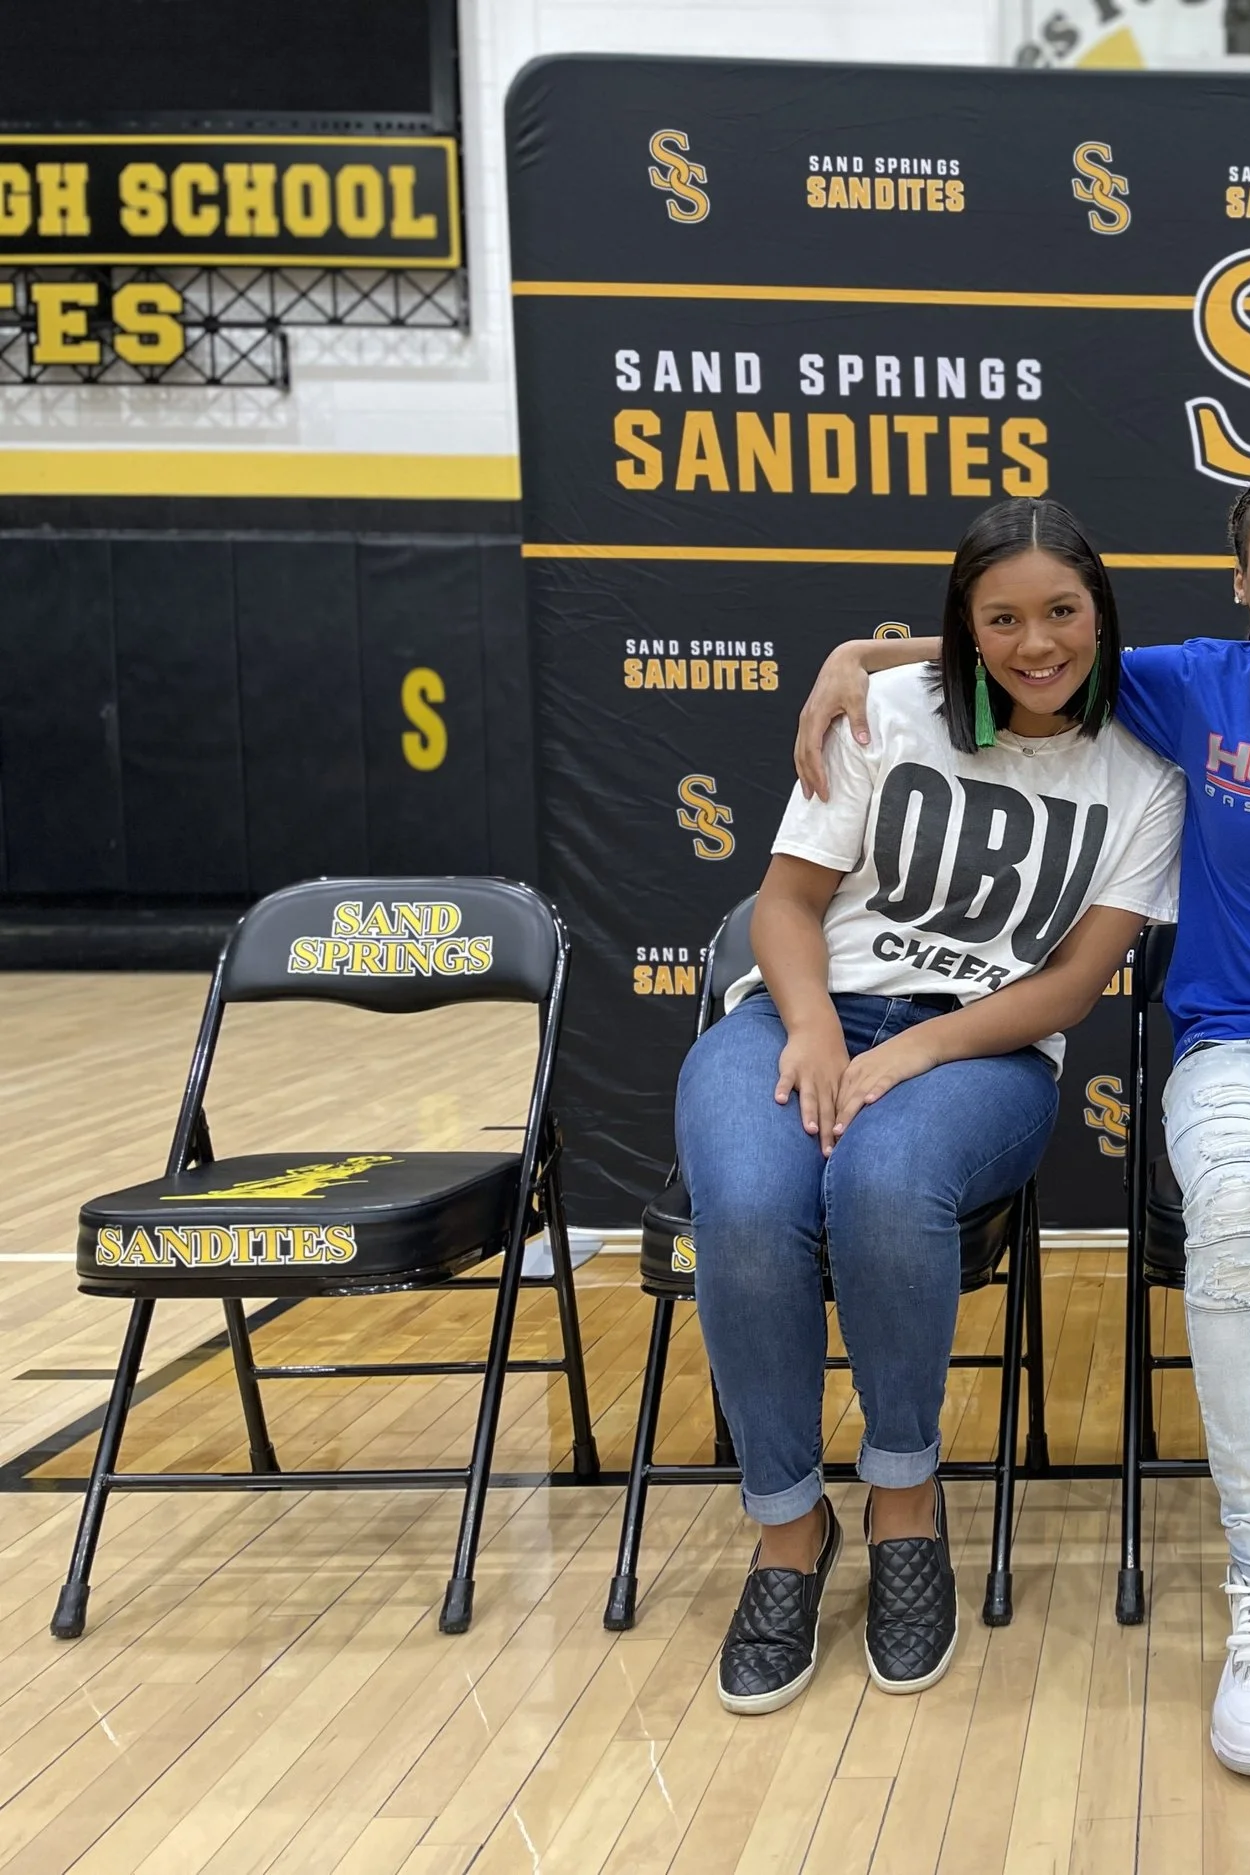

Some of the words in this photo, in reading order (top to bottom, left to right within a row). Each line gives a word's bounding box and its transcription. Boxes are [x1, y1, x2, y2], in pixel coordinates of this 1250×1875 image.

[808, 154, 864, 174] SAND
[874, 156, 961, 176] SPRINGS
[118, 162, 438, 239] SCHOOL
[806, 176, 965, 213] SANDITES
[0, 282, 186, 364] ES
[615, 349, 762, 394] SAND
[799, 353, 1042, 400] SPRINGS
[613, 409, 1050, 498] SANDITES
[625, 639, 679, 656] SAND
[690, 640, 774, 658] SPRINGS
[623, 658, 779, 692] SANDITES
[401, 667, 448, 772] S
[865, 762, 1108, 965] OBU
[333, 901, 462, 937] SAND
[288, 936, 493, 976] SPRINGS
[636, 946, 688, 962] SAND
[872, 931, 1011, 991] CHEER
[96, 1223, 357, 1267] SANDITES
